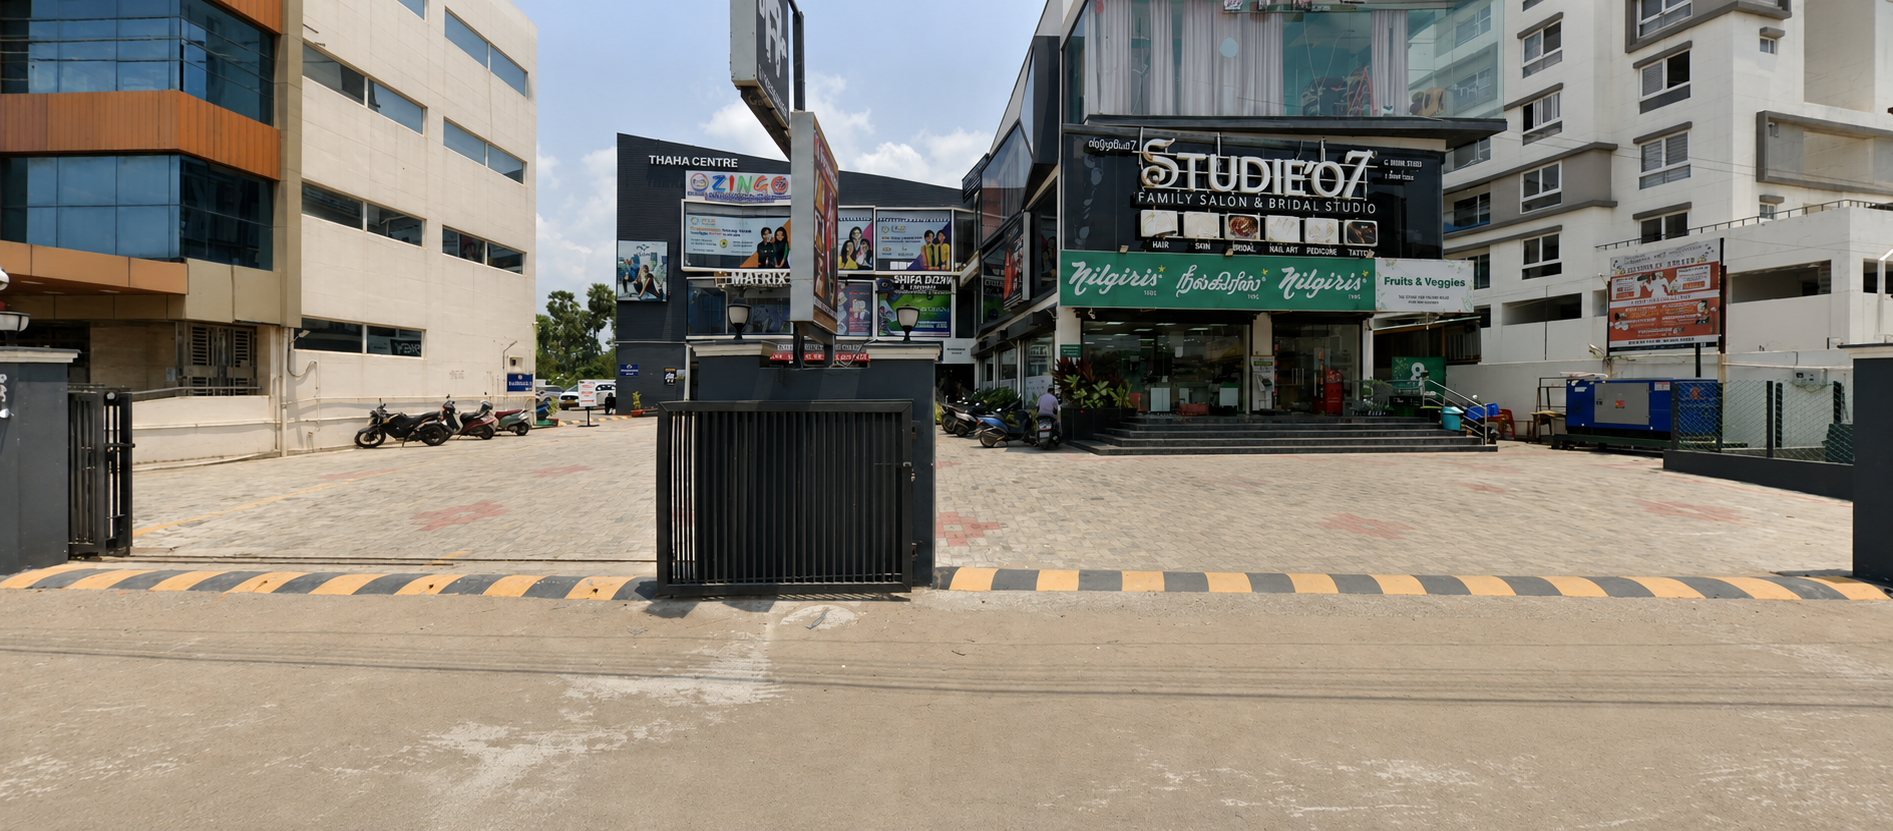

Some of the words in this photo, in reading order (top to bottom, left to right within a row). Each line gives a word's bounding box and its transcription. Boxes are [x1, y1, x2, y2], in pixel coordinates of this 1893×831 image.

[649, 155, 690, 166] THAHA
[692, 156, 738, 168] CENTRE
[712, 174, 789, 194] ZINGO
[1138, 192, 1193, 204] FAMILY
[1200, 194, 1247, 207] SALON
[1254, 198, 1263, 208] &
[1269, 198, 1319, 211] BRIDAL
[1325, 201, 1376, 214] STUDIO
[1152, 241, 1169, 249] HAIR
[1285, 246, 1299, 254] ART
[1068, 261, 1158, 296] Nilgiris
[1278, 266, 1361, 300] Nilgiris
[1384, 276, 1413, 287] Fruits
[1415, 277, 1423, 287] &
[1425, 277, 1466, 289] Veggies
